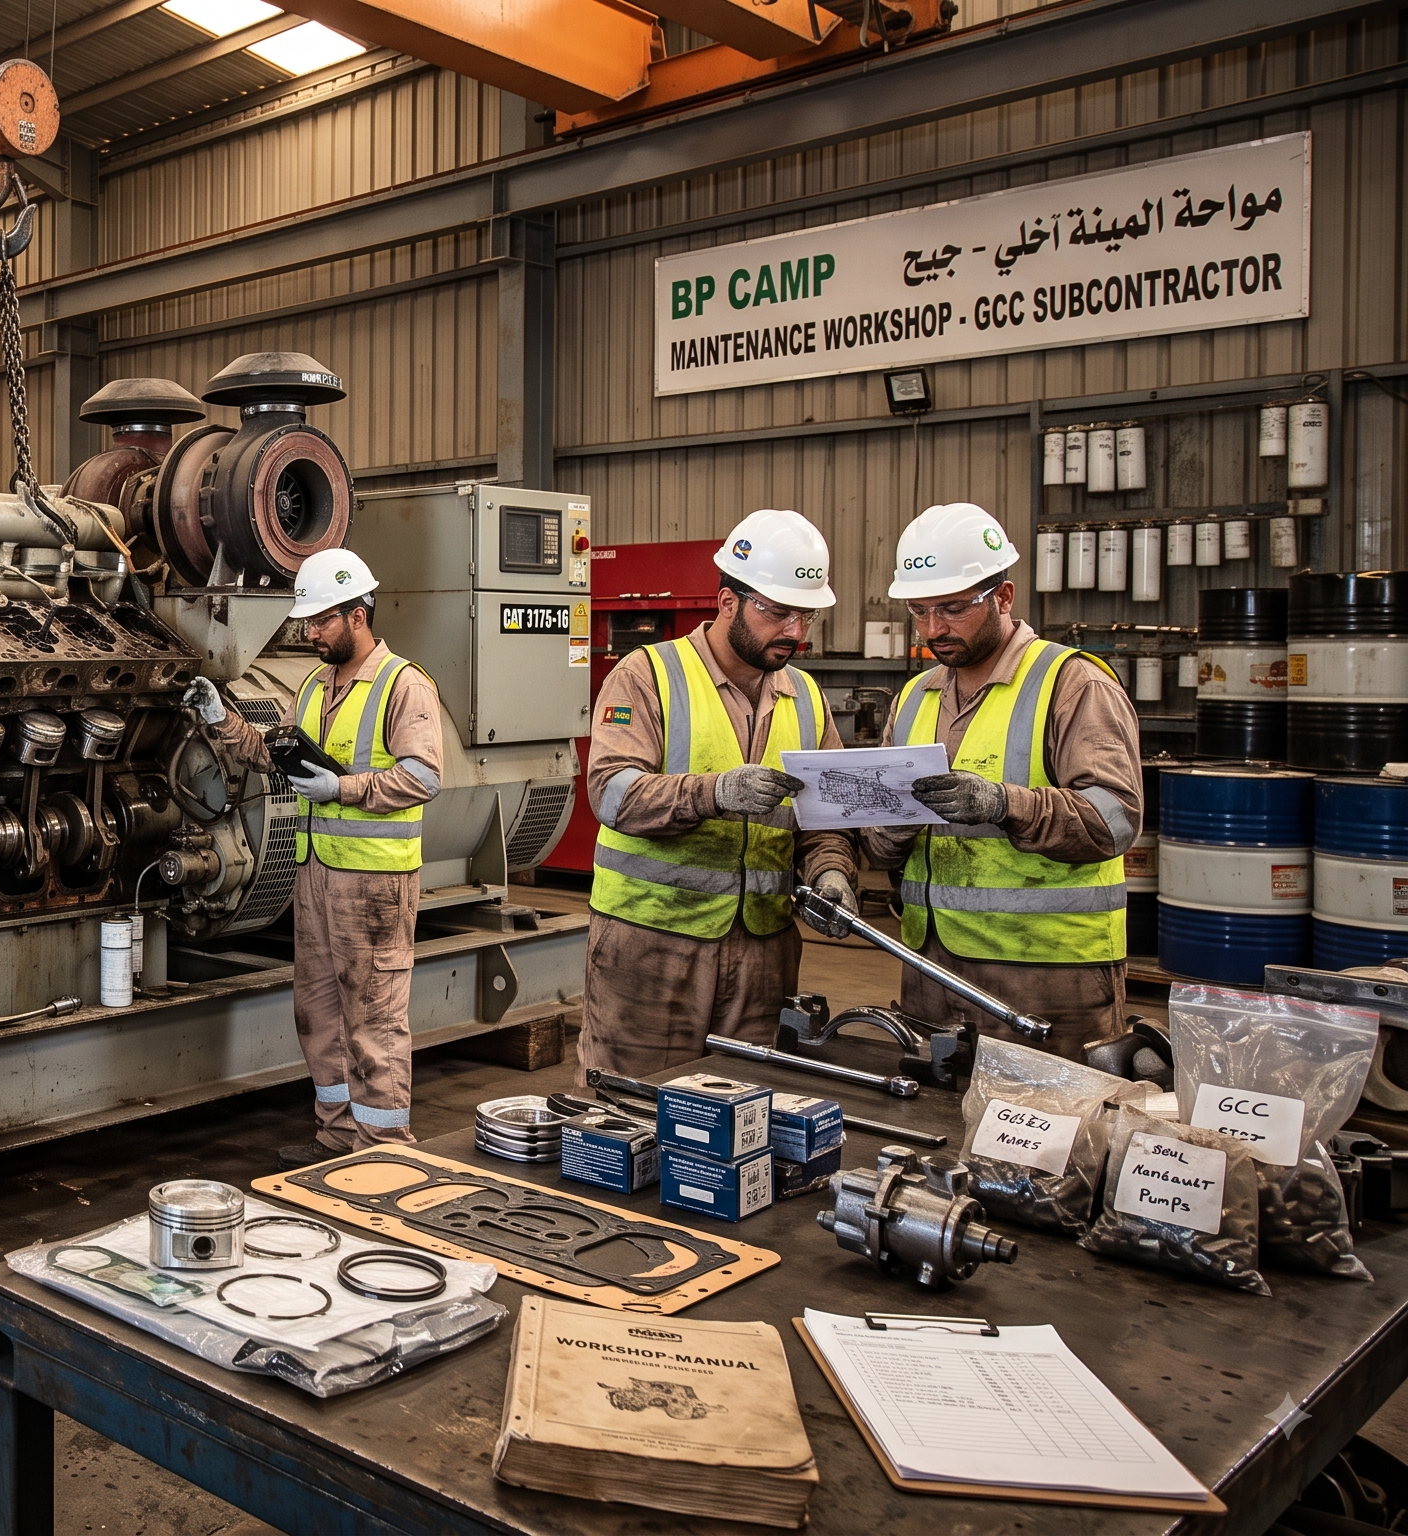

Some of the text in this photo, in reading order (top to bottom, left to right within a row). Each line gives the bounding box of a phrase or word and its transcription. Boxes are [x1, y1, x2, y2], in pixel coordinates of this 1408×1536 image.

[672, 253, 835, 320] BP CAMP
[671, 321, 816, 372] MAINTENANCE
[823, 301, 952, 351] WORKSHOP
[974, 290, 1025, 331] GCC
[1032, 252, 1282, 323] SUBCONTRACTOR
[794, 567, 823, 579] GCC
[904, 555, 937, 570] GCC
[503, 607, 569, 630] CAT 3175-16
[1218, 1096, 1270, 1118] GCC
[556, 1336, 760, 1371] WORKSHOP-MANUAL
